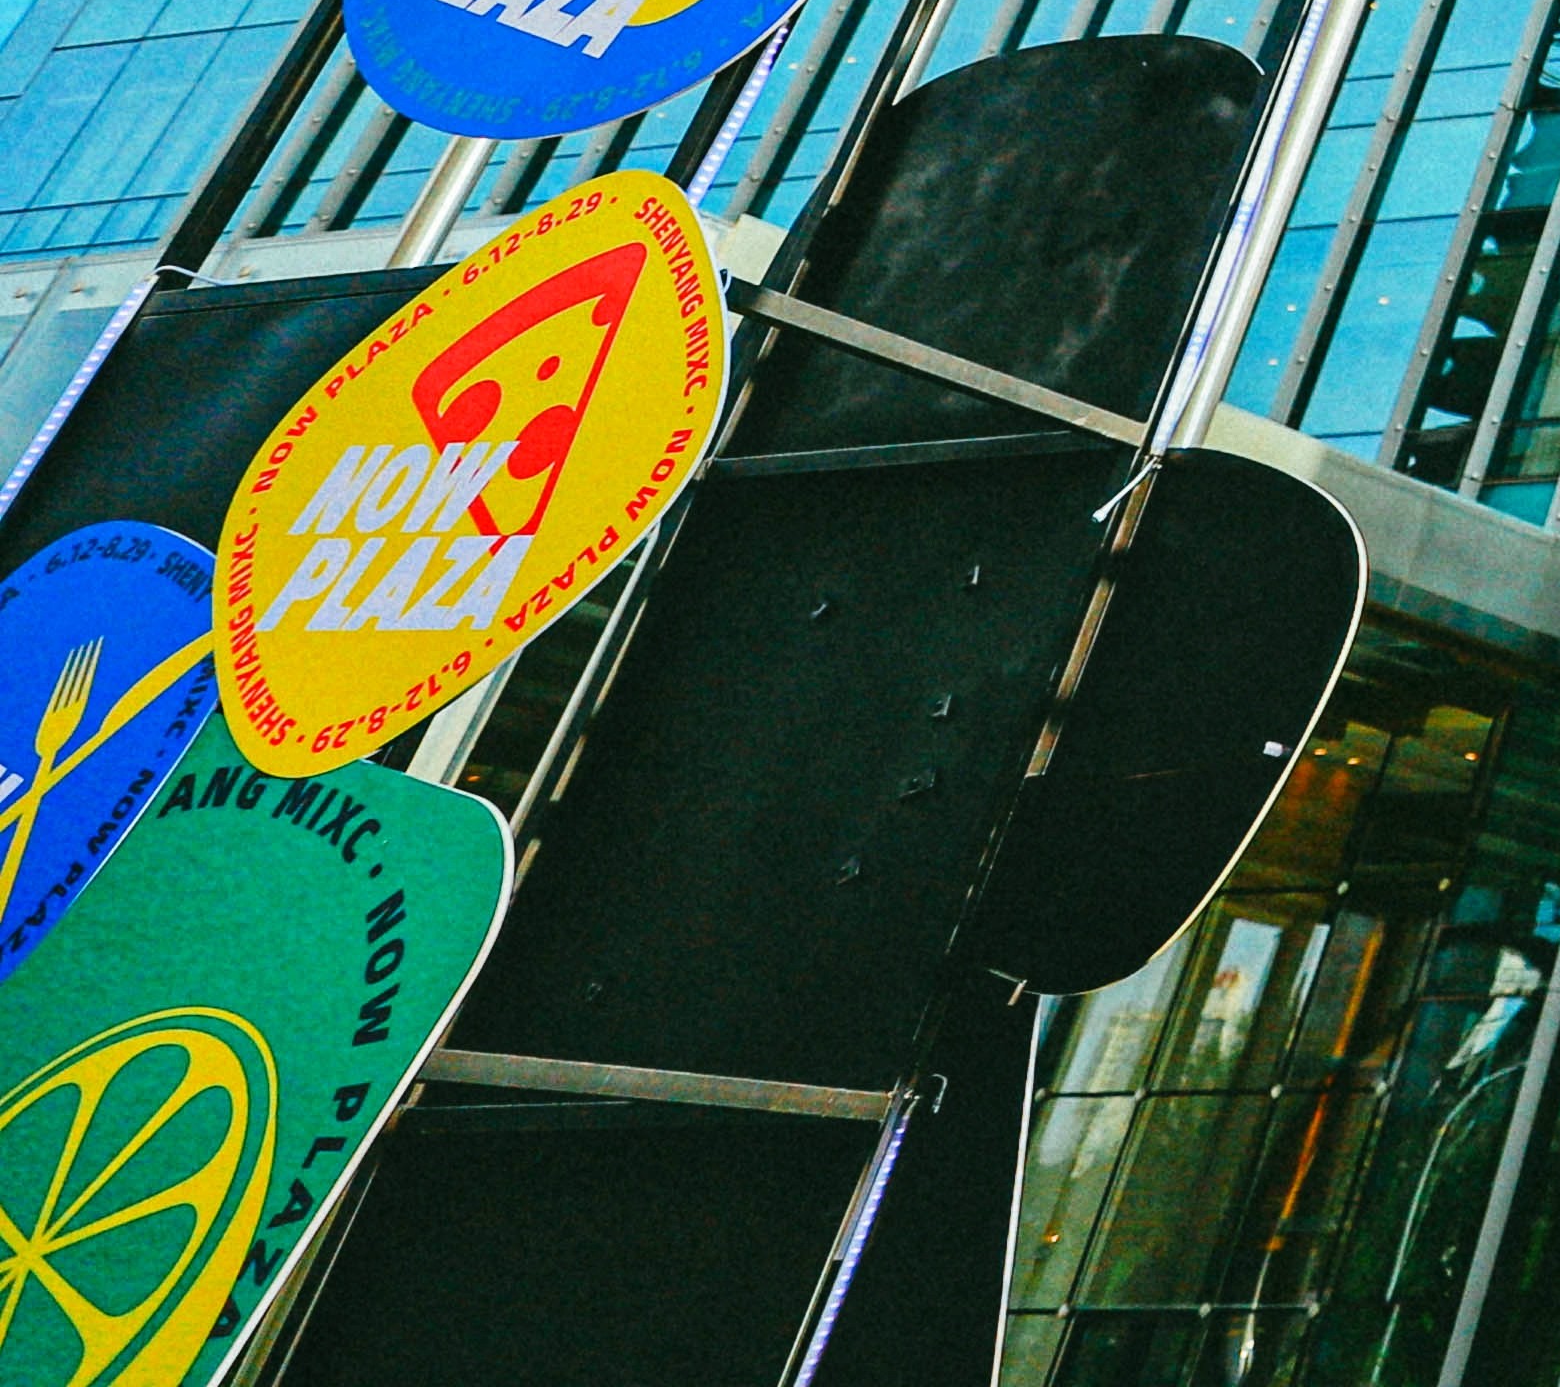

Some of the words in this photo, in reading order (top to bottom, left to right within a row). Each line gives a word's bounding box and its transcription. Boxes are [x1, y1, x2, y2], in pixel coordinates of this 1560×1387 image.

[463, 191, 603, 284] 6.12-8.29
[634, 197, 705, 318] SHENYANG
[325, 302, 433, 399] PLAZA
[682, 317, 709, 399] MIXC
[253, 406, 318, 493] NOW
[289, 441, 522, 534] NOW
[626, 429, 691, 522] NOW
[44, 535, 150, 574] 6.12-8.29
[230, 522, 258, 602] MIXC
[254, 535, 534, 631] PLAZA
[504, 526, 619, 631] PLAZA
[229, 604, 297, 746] SHENYANG
[311, 651, 470, 753] 6.12-8.29
[89, 769, 155, 856] NOW
[0, 862, 83, 963] PLAZ
[275, 775, 377, 864] MIXC
[353, 888, 404, 1046] NOW
